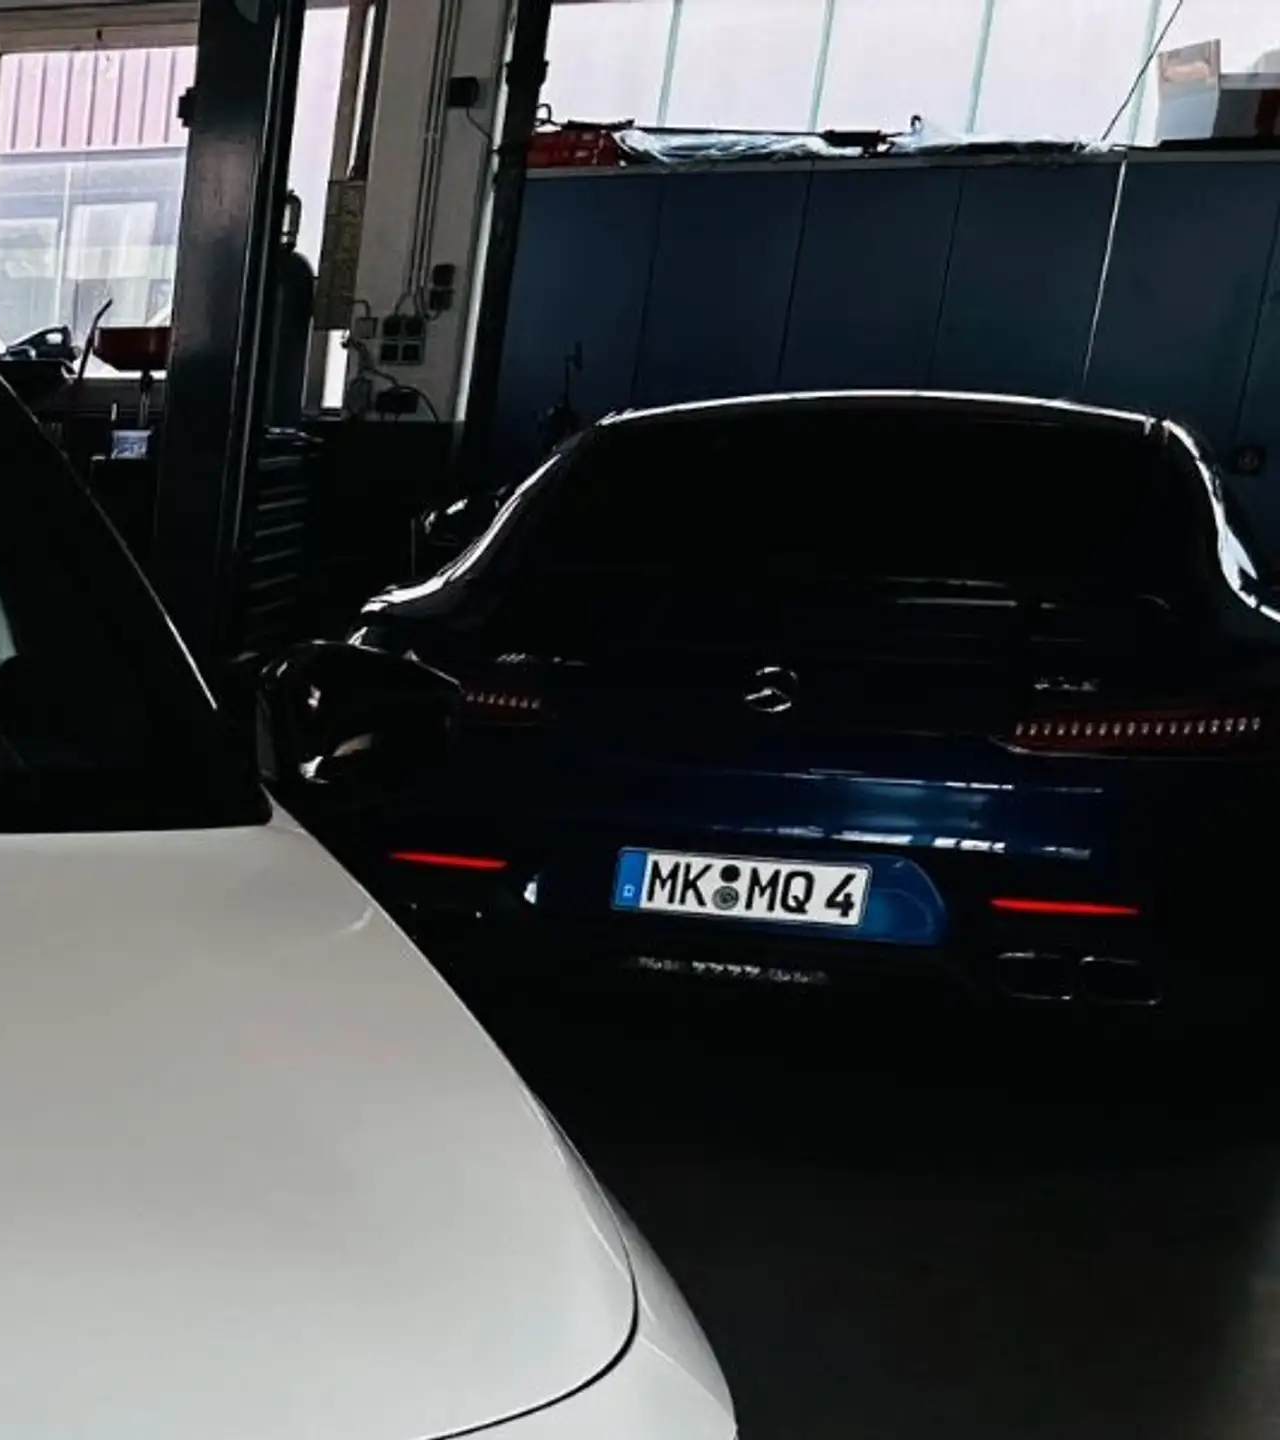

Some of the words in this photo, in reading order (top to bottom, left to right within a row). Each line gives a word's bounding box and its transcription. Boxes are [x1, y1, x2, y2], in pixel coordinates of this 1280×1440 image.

[647, 860, 713, 907] MK
[745, 867, 815, 914] MQ
[824, 873, 856, 918] 4
